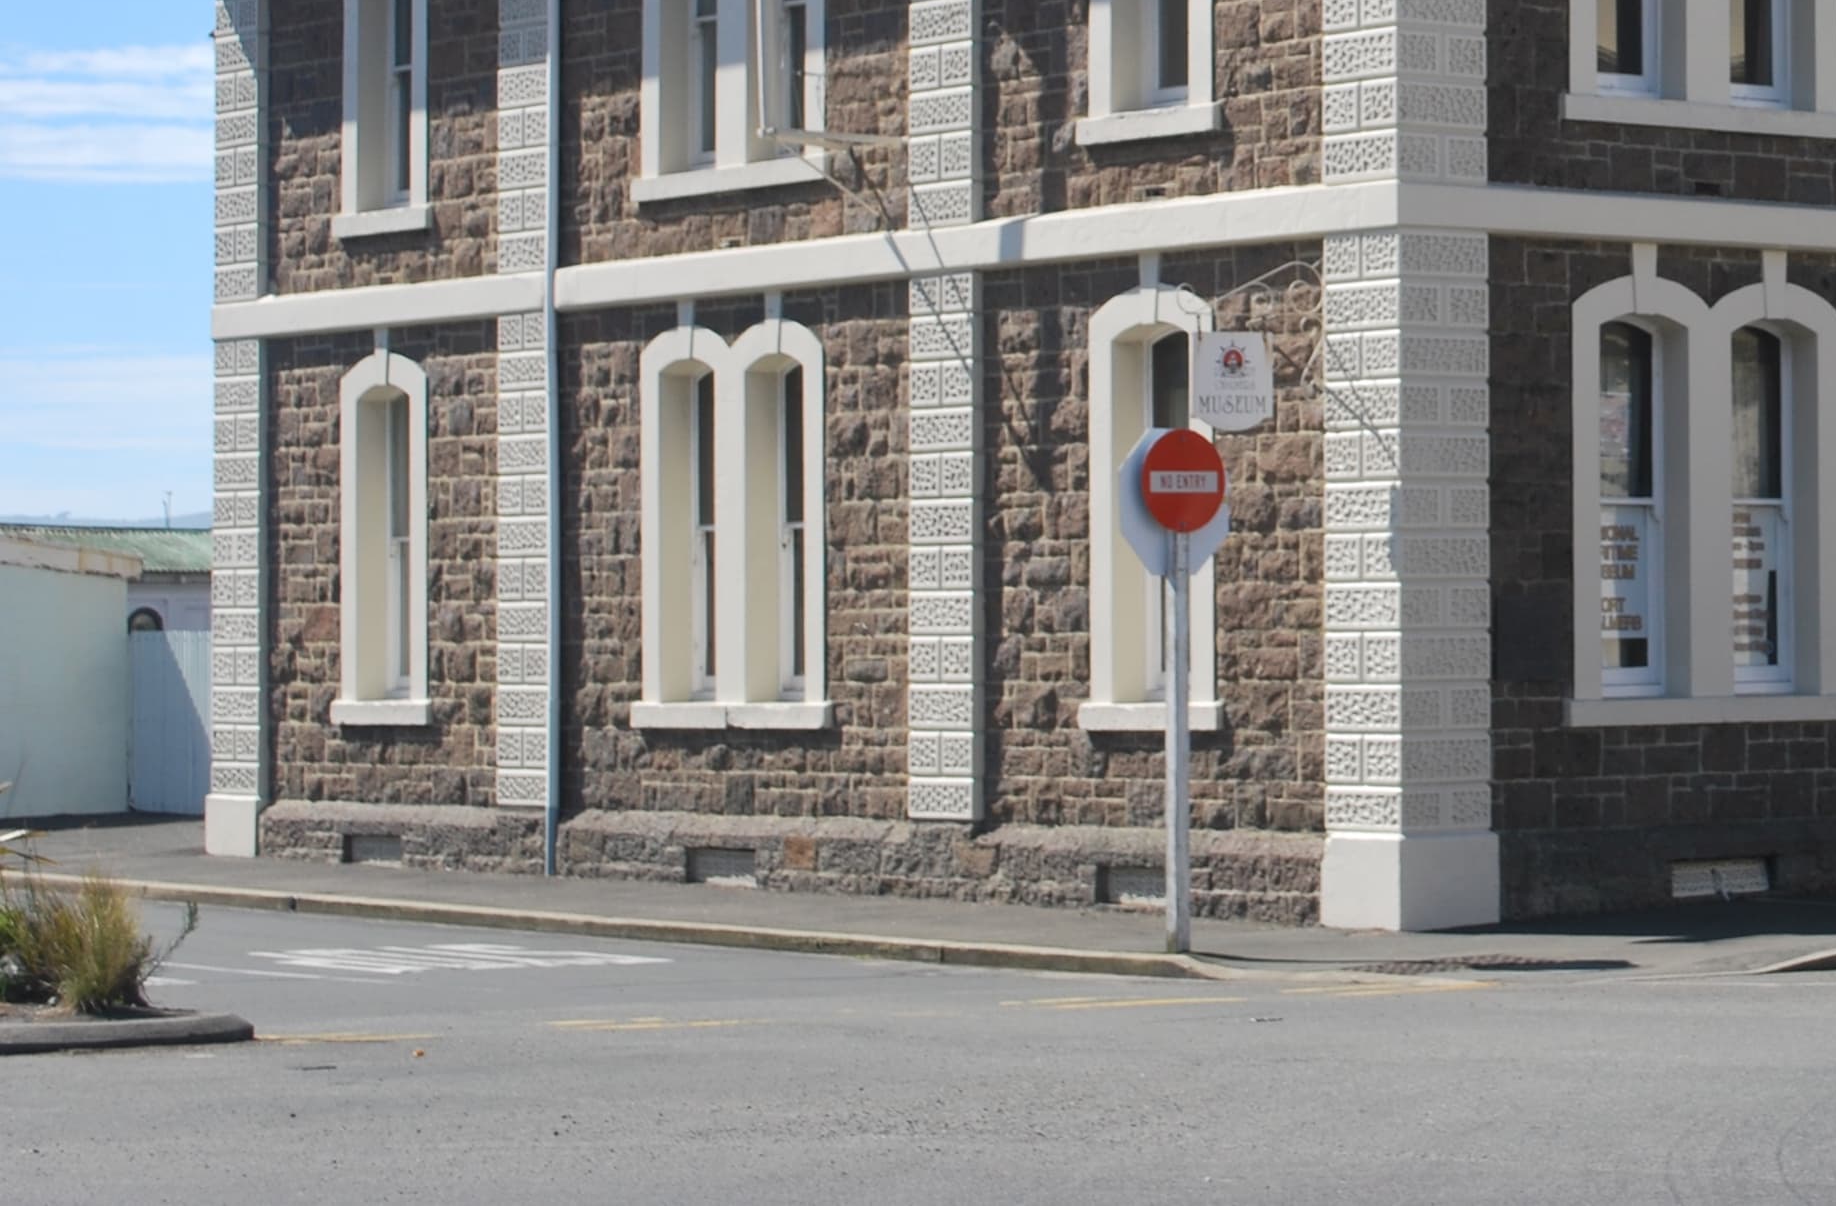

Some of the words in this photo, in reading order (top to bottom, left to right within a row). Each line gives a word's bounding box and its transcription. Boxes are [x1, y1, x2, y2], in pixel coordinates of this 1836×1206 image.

[1199, 394, 1267, 415] MUSEUM
[1160, 474, 1173, 489] NO
[1176, 473, 1207, 489] ENTRY
